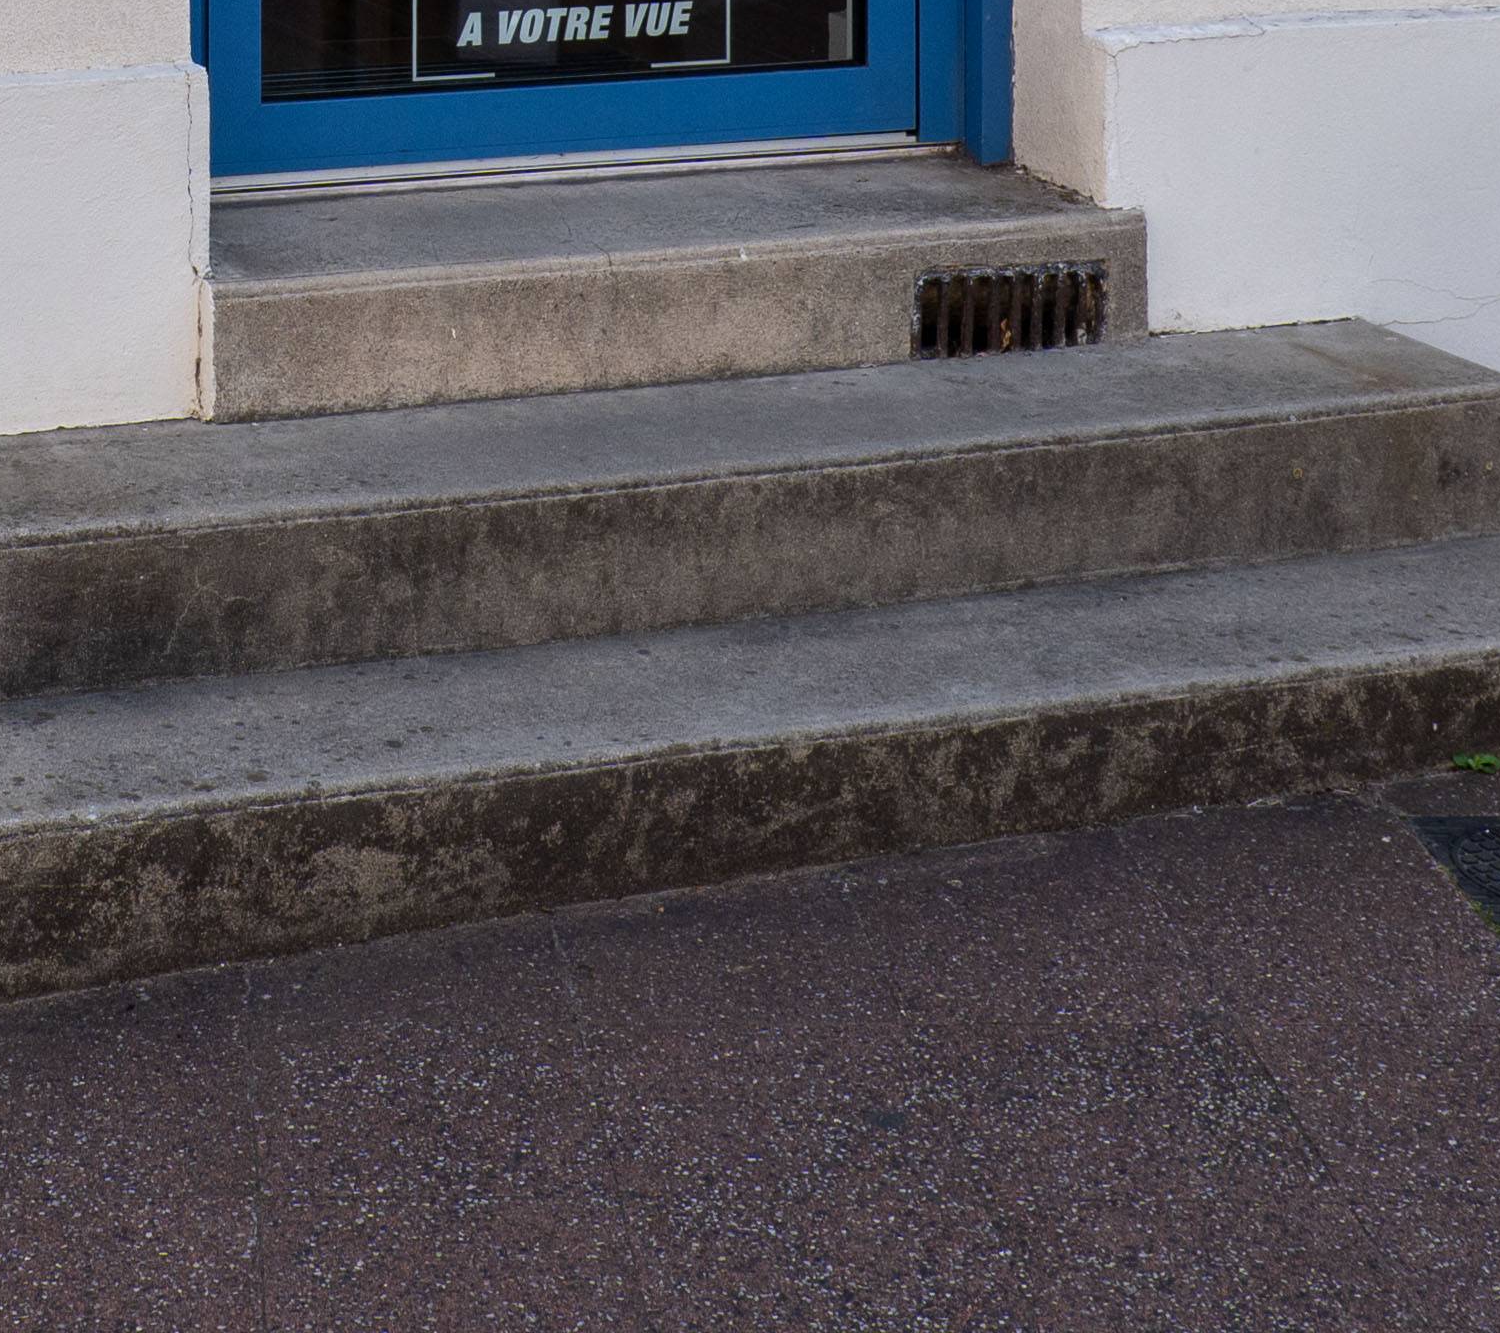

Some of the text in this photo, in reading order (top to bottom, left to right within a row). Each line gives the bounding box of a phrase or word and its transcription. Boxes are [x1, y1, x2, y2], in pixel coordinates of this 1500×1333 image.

[456, 1, 693, 47] A VOTRE VUE
